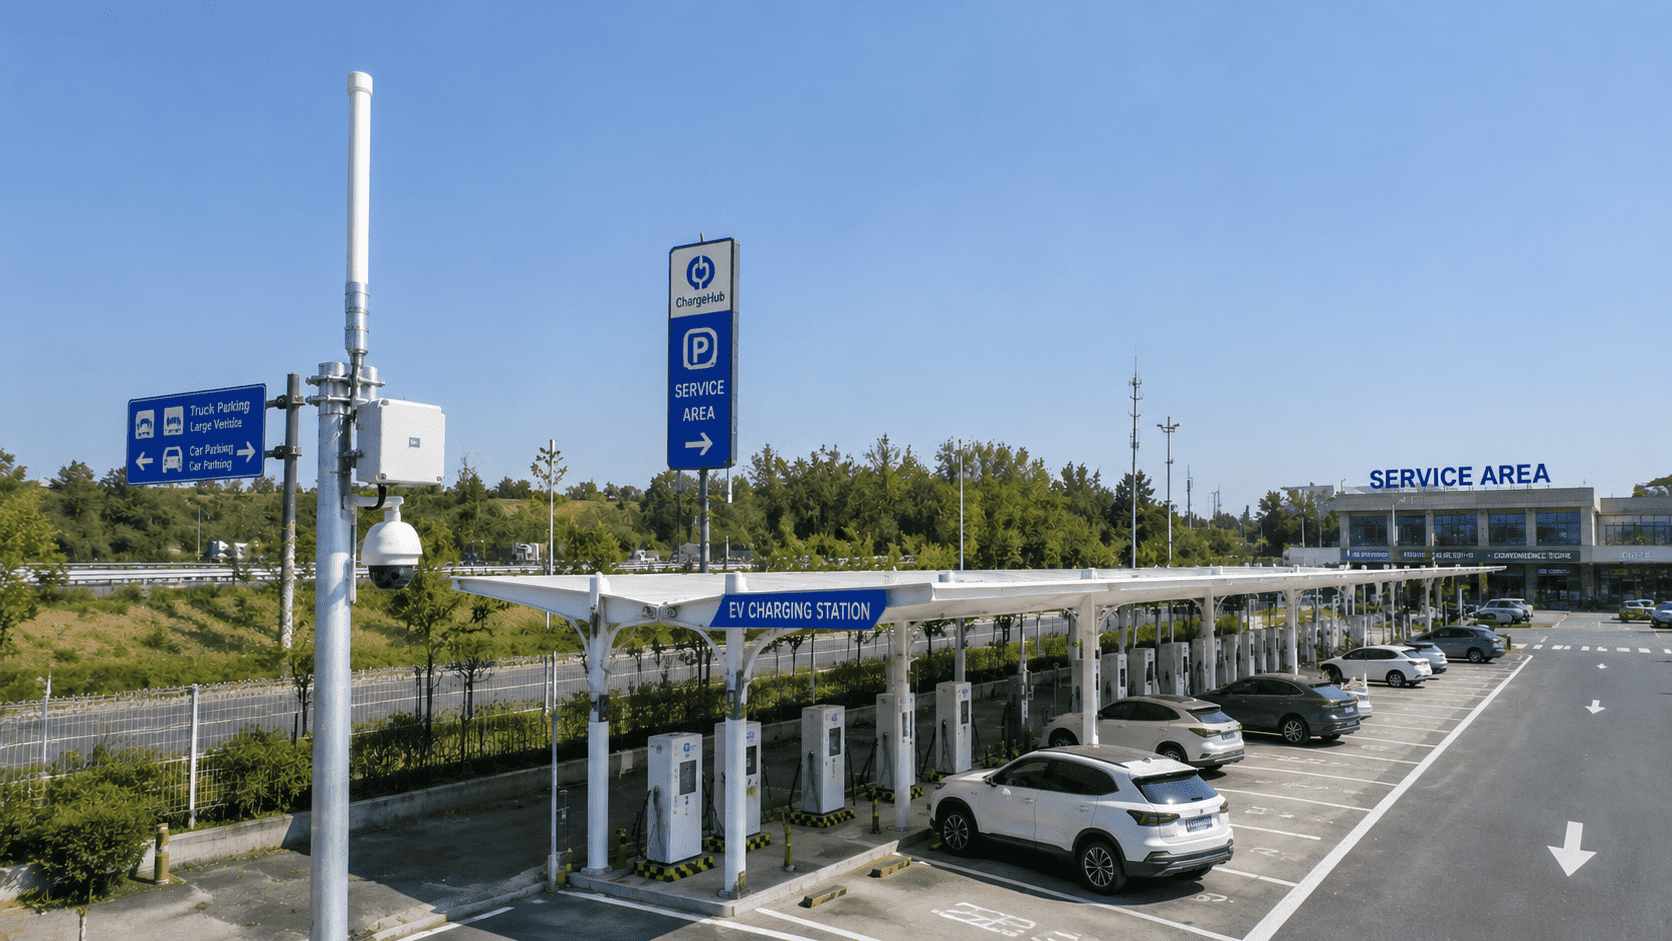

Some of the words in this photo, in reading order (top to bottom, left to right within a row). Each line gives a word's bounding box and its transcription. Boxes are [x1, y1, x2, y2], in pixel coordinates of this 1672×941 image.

[675, 291, 725, 308] ChargeHub
[692, 336, 709, 363] P
[674, 380, 725, 398] SERVICE
[190, 403, 215, 416] Truck
[682, 405, 716, 422] AREA
[190, 422, 212, 433] Large
[189, 445, 203, 456] Car
[1370, 466, 1473, 489] SERVICE
[1480, 463, 1551, 486] AREA
[729, 601, 745, 619] EV
[748, 601, 812, 619] CHARGING
[816, 602, 870, 620] STATION
